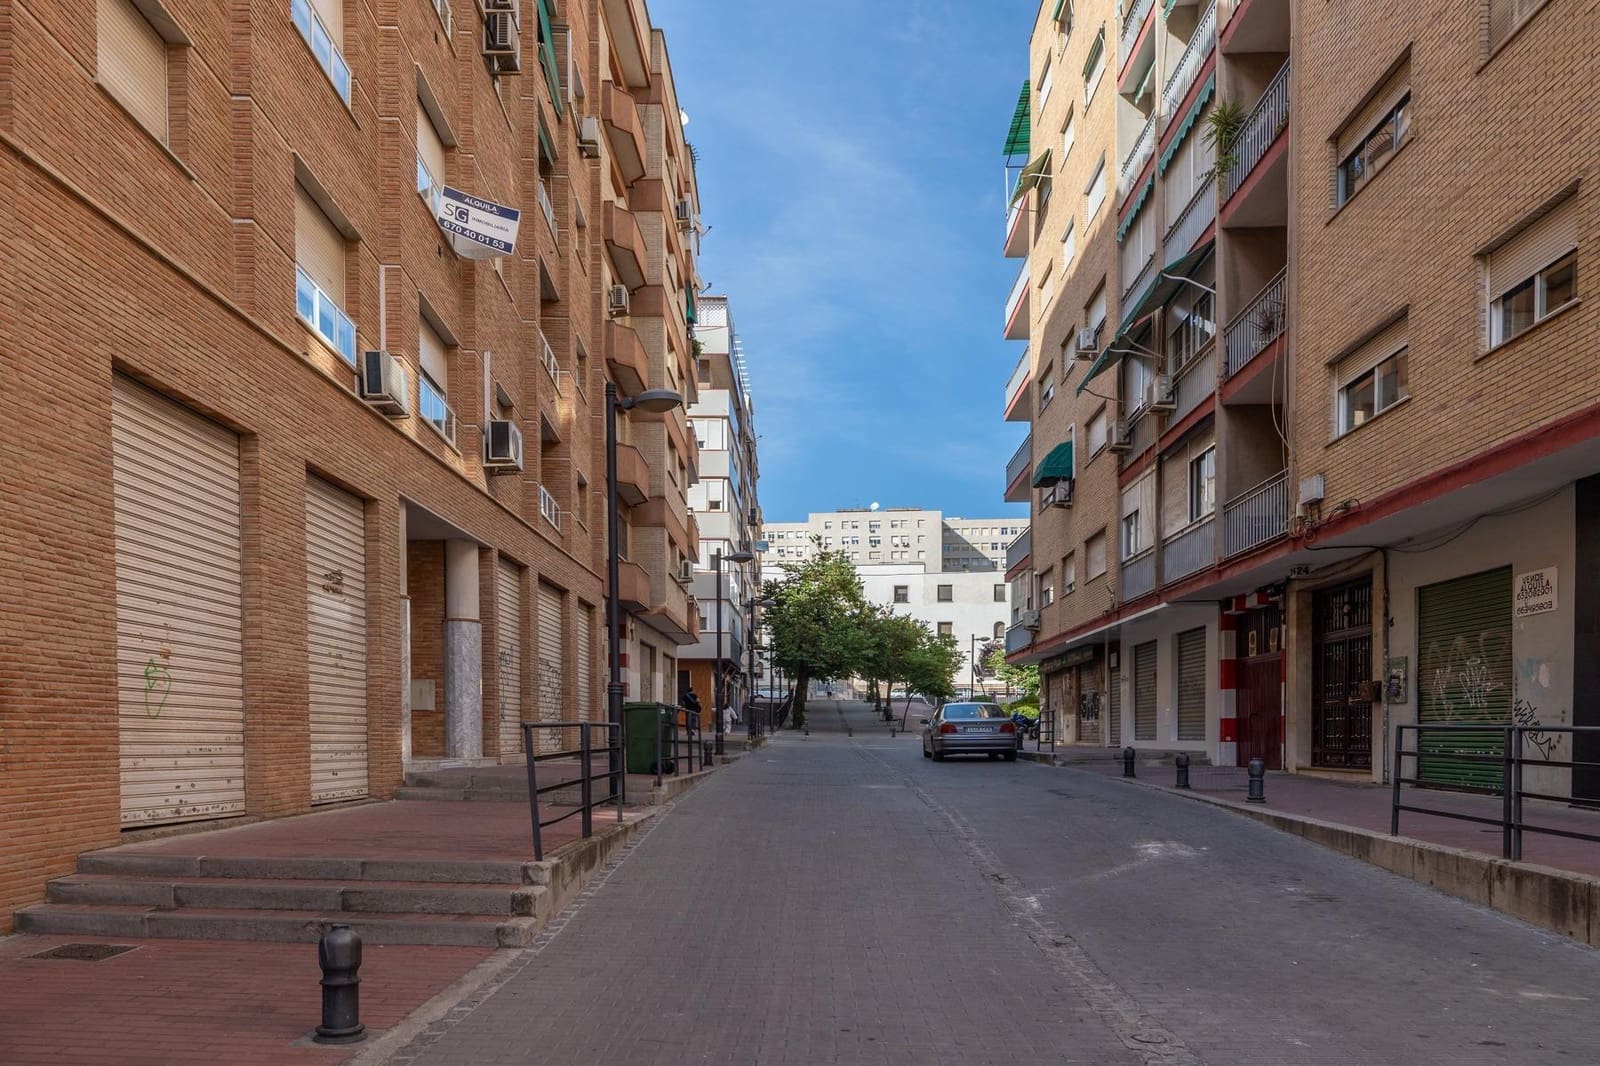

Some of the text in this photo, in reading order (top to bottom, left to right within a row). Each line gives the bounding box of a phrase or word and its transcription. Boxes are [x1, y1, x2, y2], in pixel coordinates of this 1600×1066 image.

[464, 197, 498, 212] ALQUILA
[444, 203, 469, 224] SG
[443, 220, 505, 249] 670 40 01 53
[1520, 579, 1550, 592] ALQUILA
[1522, 573, 1544, 584] VENDE
